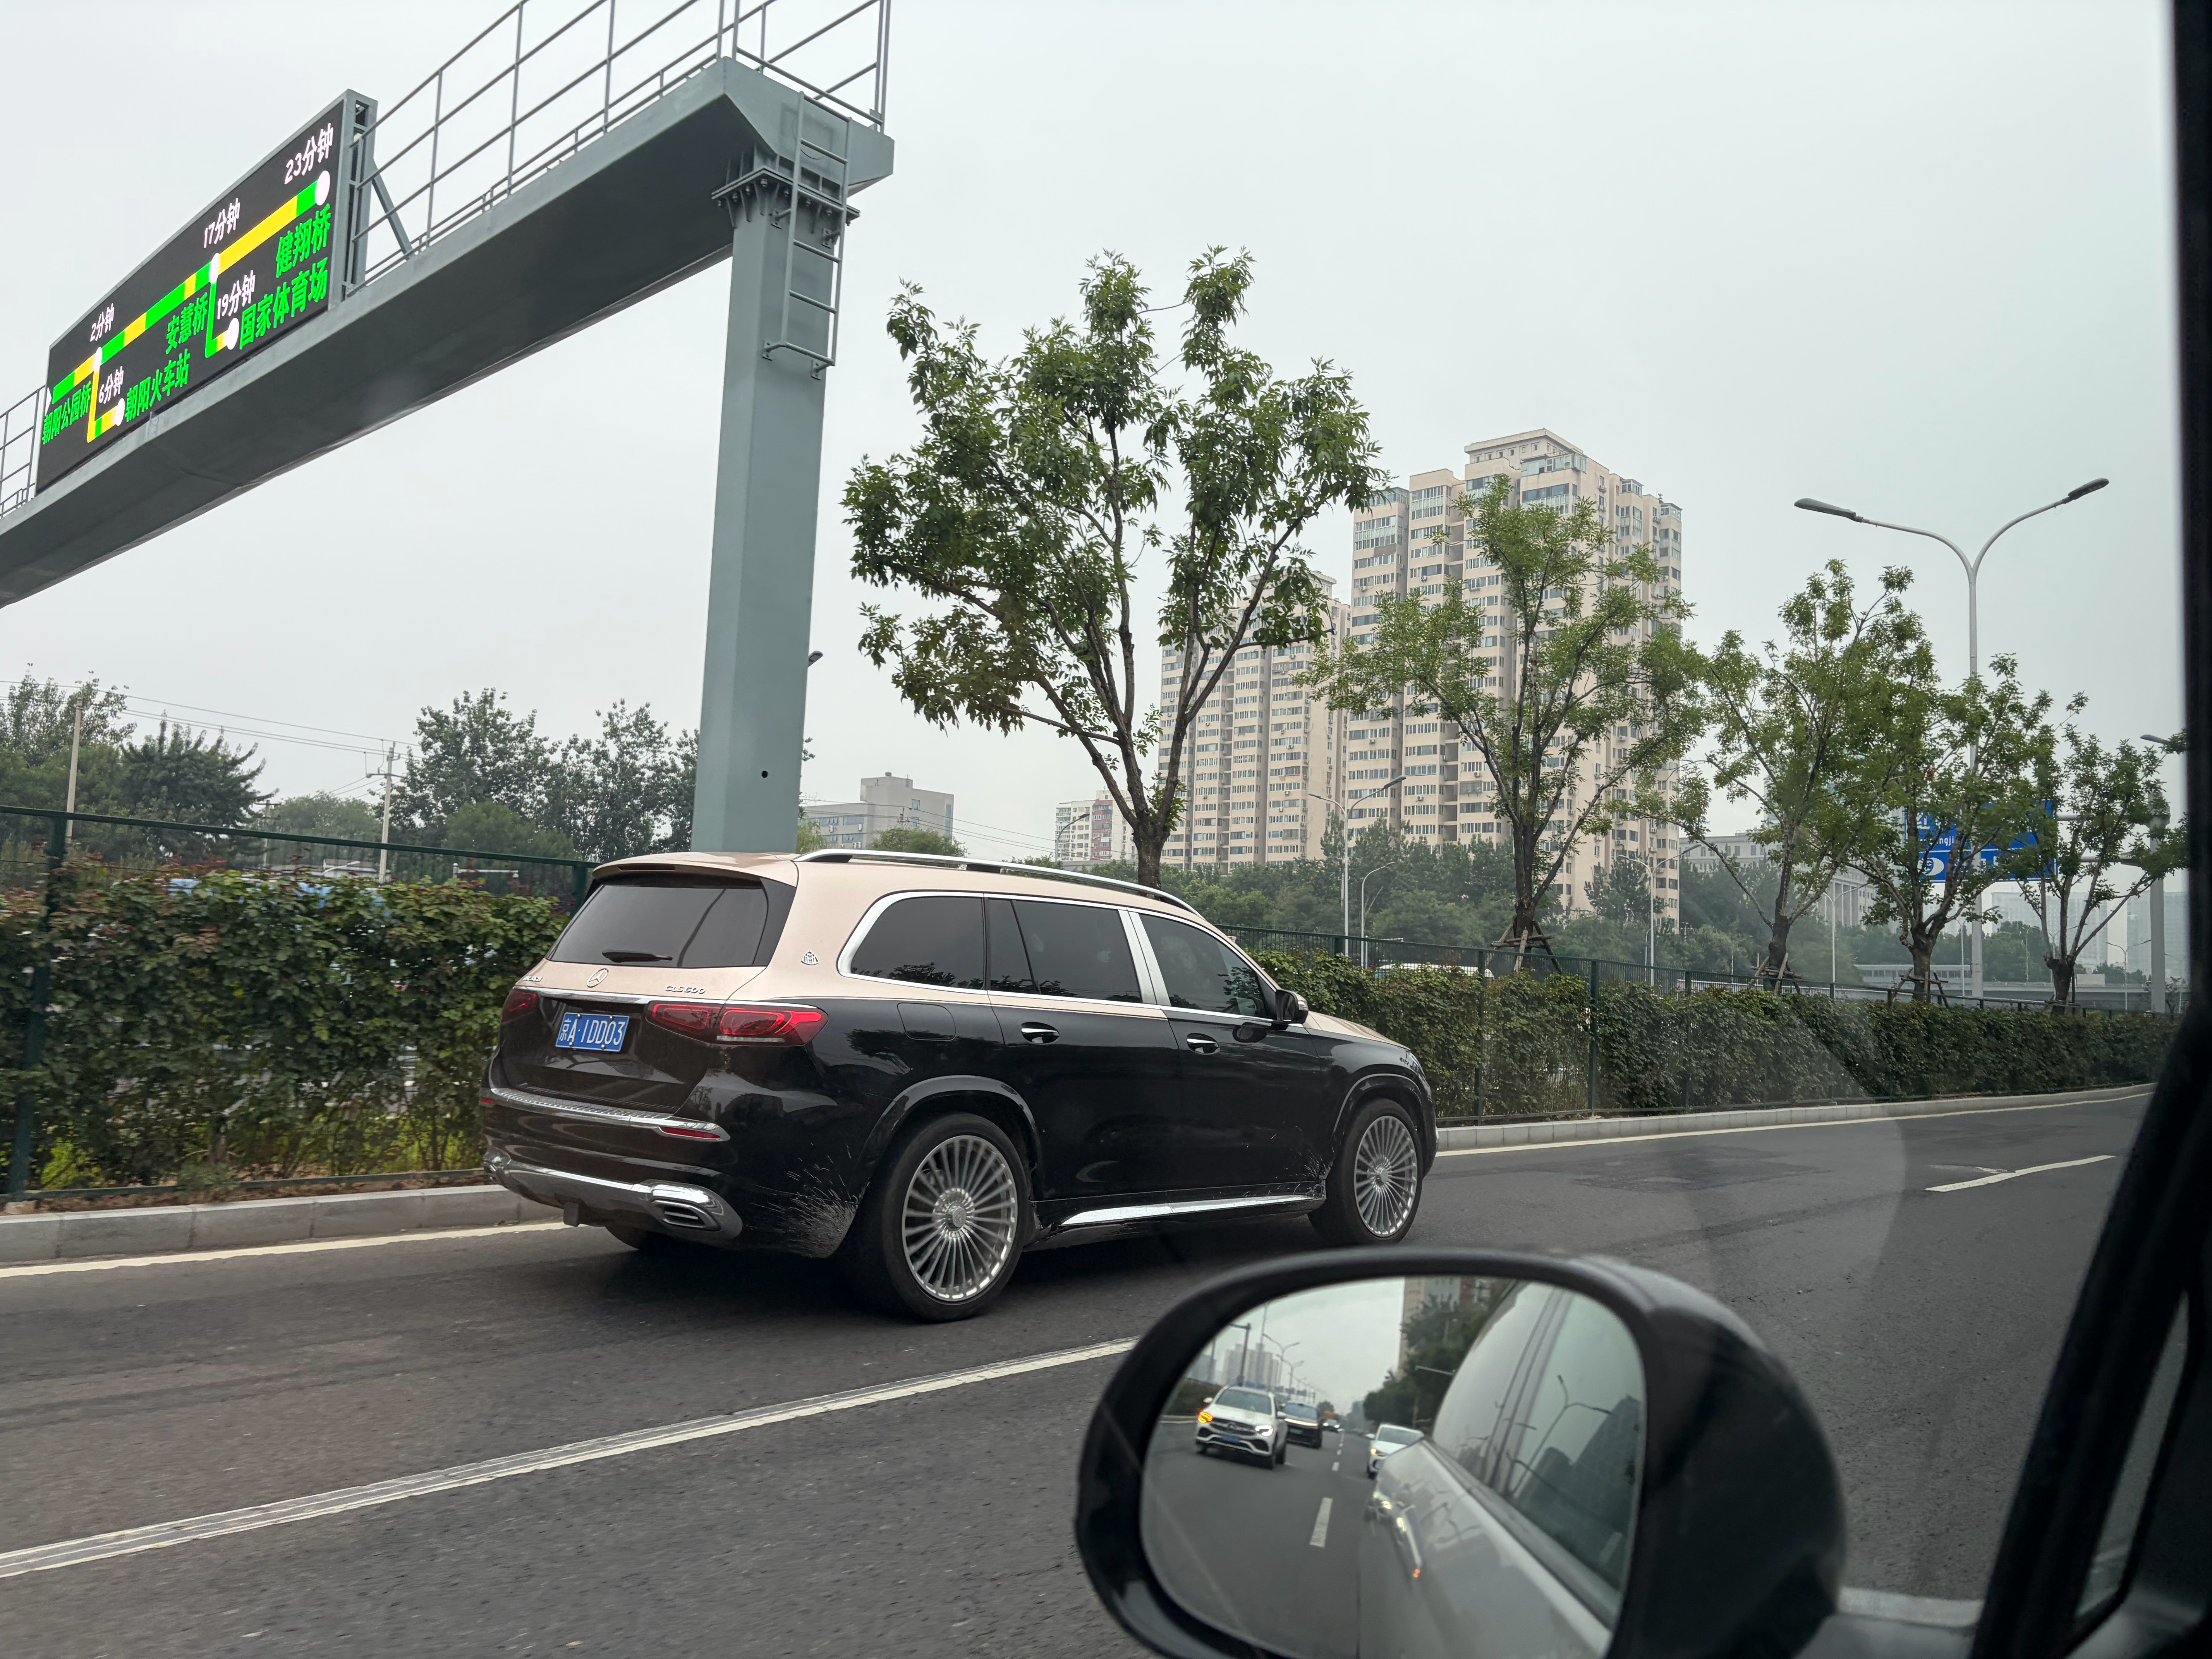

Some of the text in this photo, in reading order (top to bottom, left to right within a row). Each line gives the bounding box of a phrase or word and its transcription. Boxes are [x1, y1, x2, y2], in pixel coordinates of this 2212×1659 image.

[284, 122, 334, 185] 23分钟
[204, 198, 240, 248] 17分钟
[276, 203, 331, 278] 健翔桥
[90, 303, 115, 342] 2分钟
[166, 292, 208, 355] 安慧桥
[217, 270, 256, 320] 19分钟
[239, 257, 328, 350] 国家体育场
[42, 380, 92, 445] 朝阳公园桥
[98, 366, 124, 404] 6分钟
[125, 349, 191, 422] 朝阳火车站
